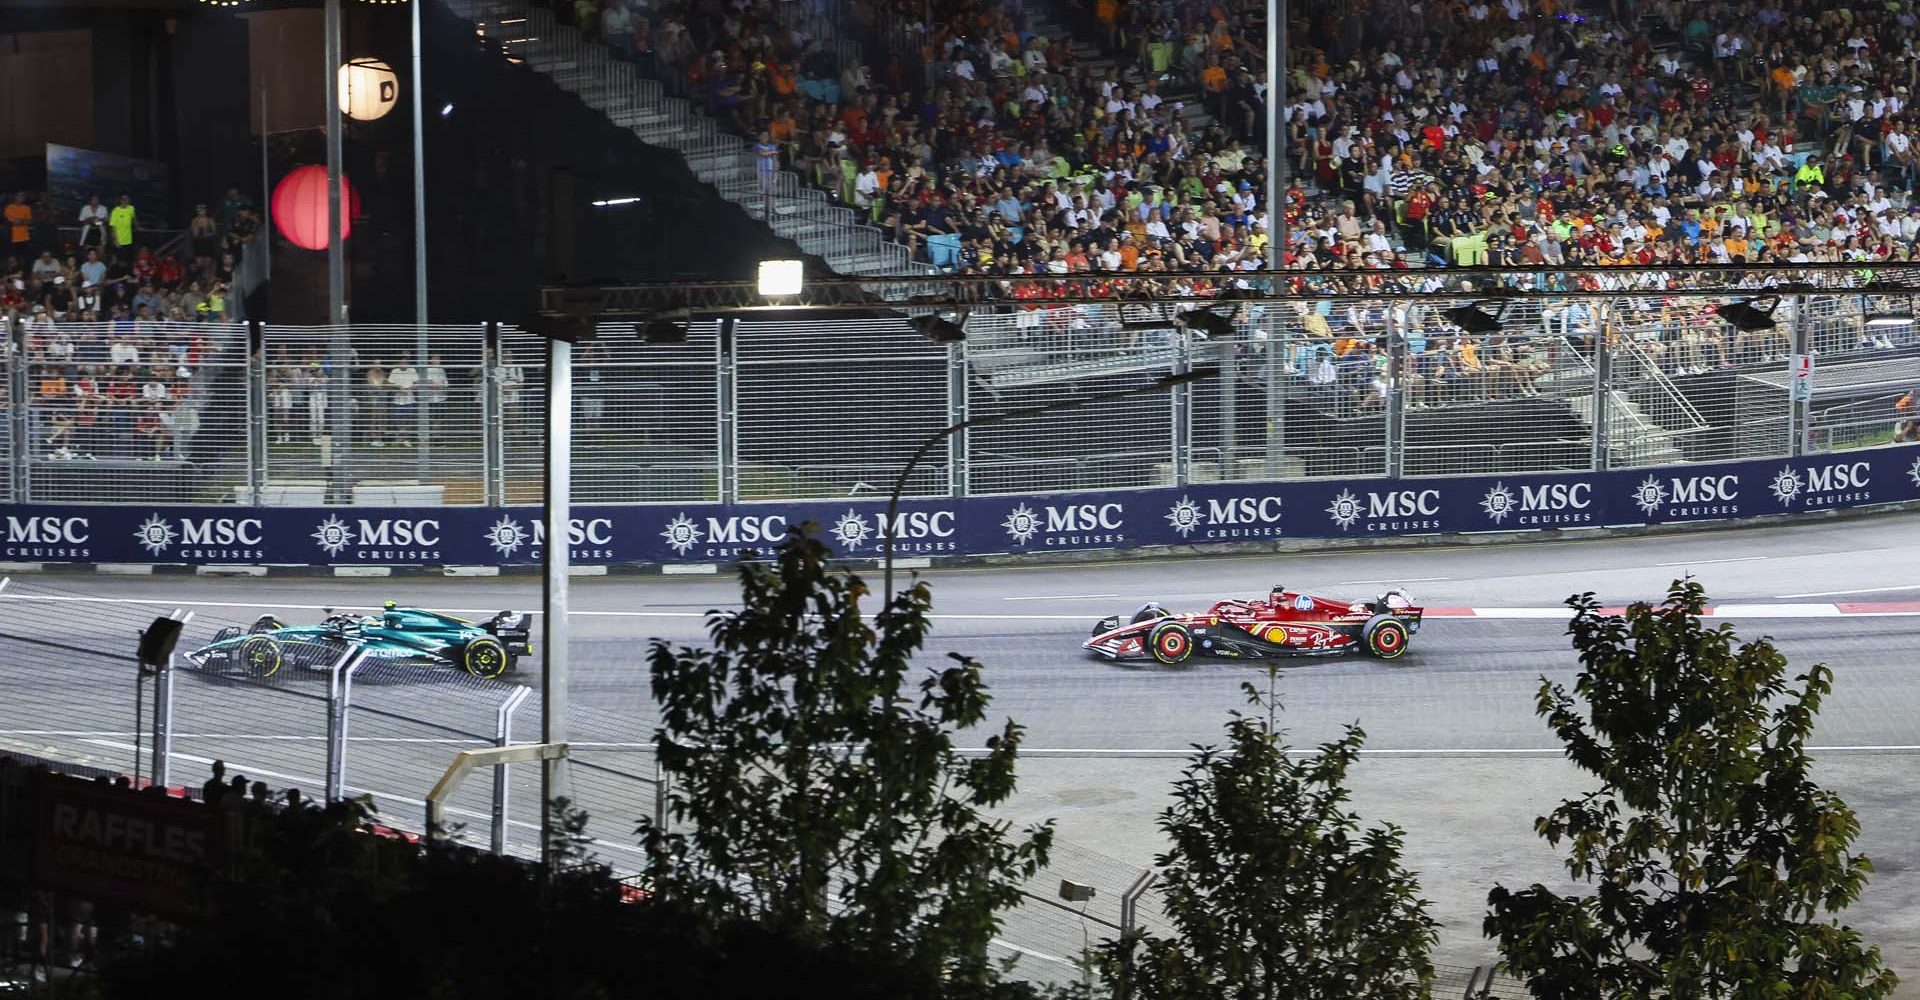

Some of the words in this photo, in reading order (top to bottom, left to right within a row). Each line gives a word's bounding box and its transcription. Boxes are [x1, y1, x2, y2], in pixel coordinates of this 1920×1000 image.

[1671, 475, 1738, 503] MSC
[1807, 463, 1870, 493] MSC
[1207, 497, 1282, 524] MSC
[1368, 490, 1440, 518] MSC
[1520, 483, 1591, 511] MSC
[1670, 505, 1738, 516] CRUISES
[1806, 491, 1870, 506] CRUISES
[6, 516, 89, 544] MSC
[181, 518, 262, 545] MSC
[706, 516, 787, 543] MSC
[875, 511, 955, 539] MSC
[1046, 504, 1123, 532] MSC
[1367, 520, 1440, 531] CRUISES
[1519, 513, 1591, 524] CRUISES
[358, 519, 440, 546] MSC
[1046, 534, 1123, 545] CRUISES
[1207, 527, 1282, 538] CRUISES
[6, 547, 89, 557] CRUISES
[181, 549, 263, 558] CRUISES
[358, 550, 440, 559] CRUISES
[530, 549, 613, 559] CISES
[1297, 595, 1312, 610] hp
[54, 802, 206, 863] RAFFLES
[55, 845, 187, 887] GRANDSTAN
